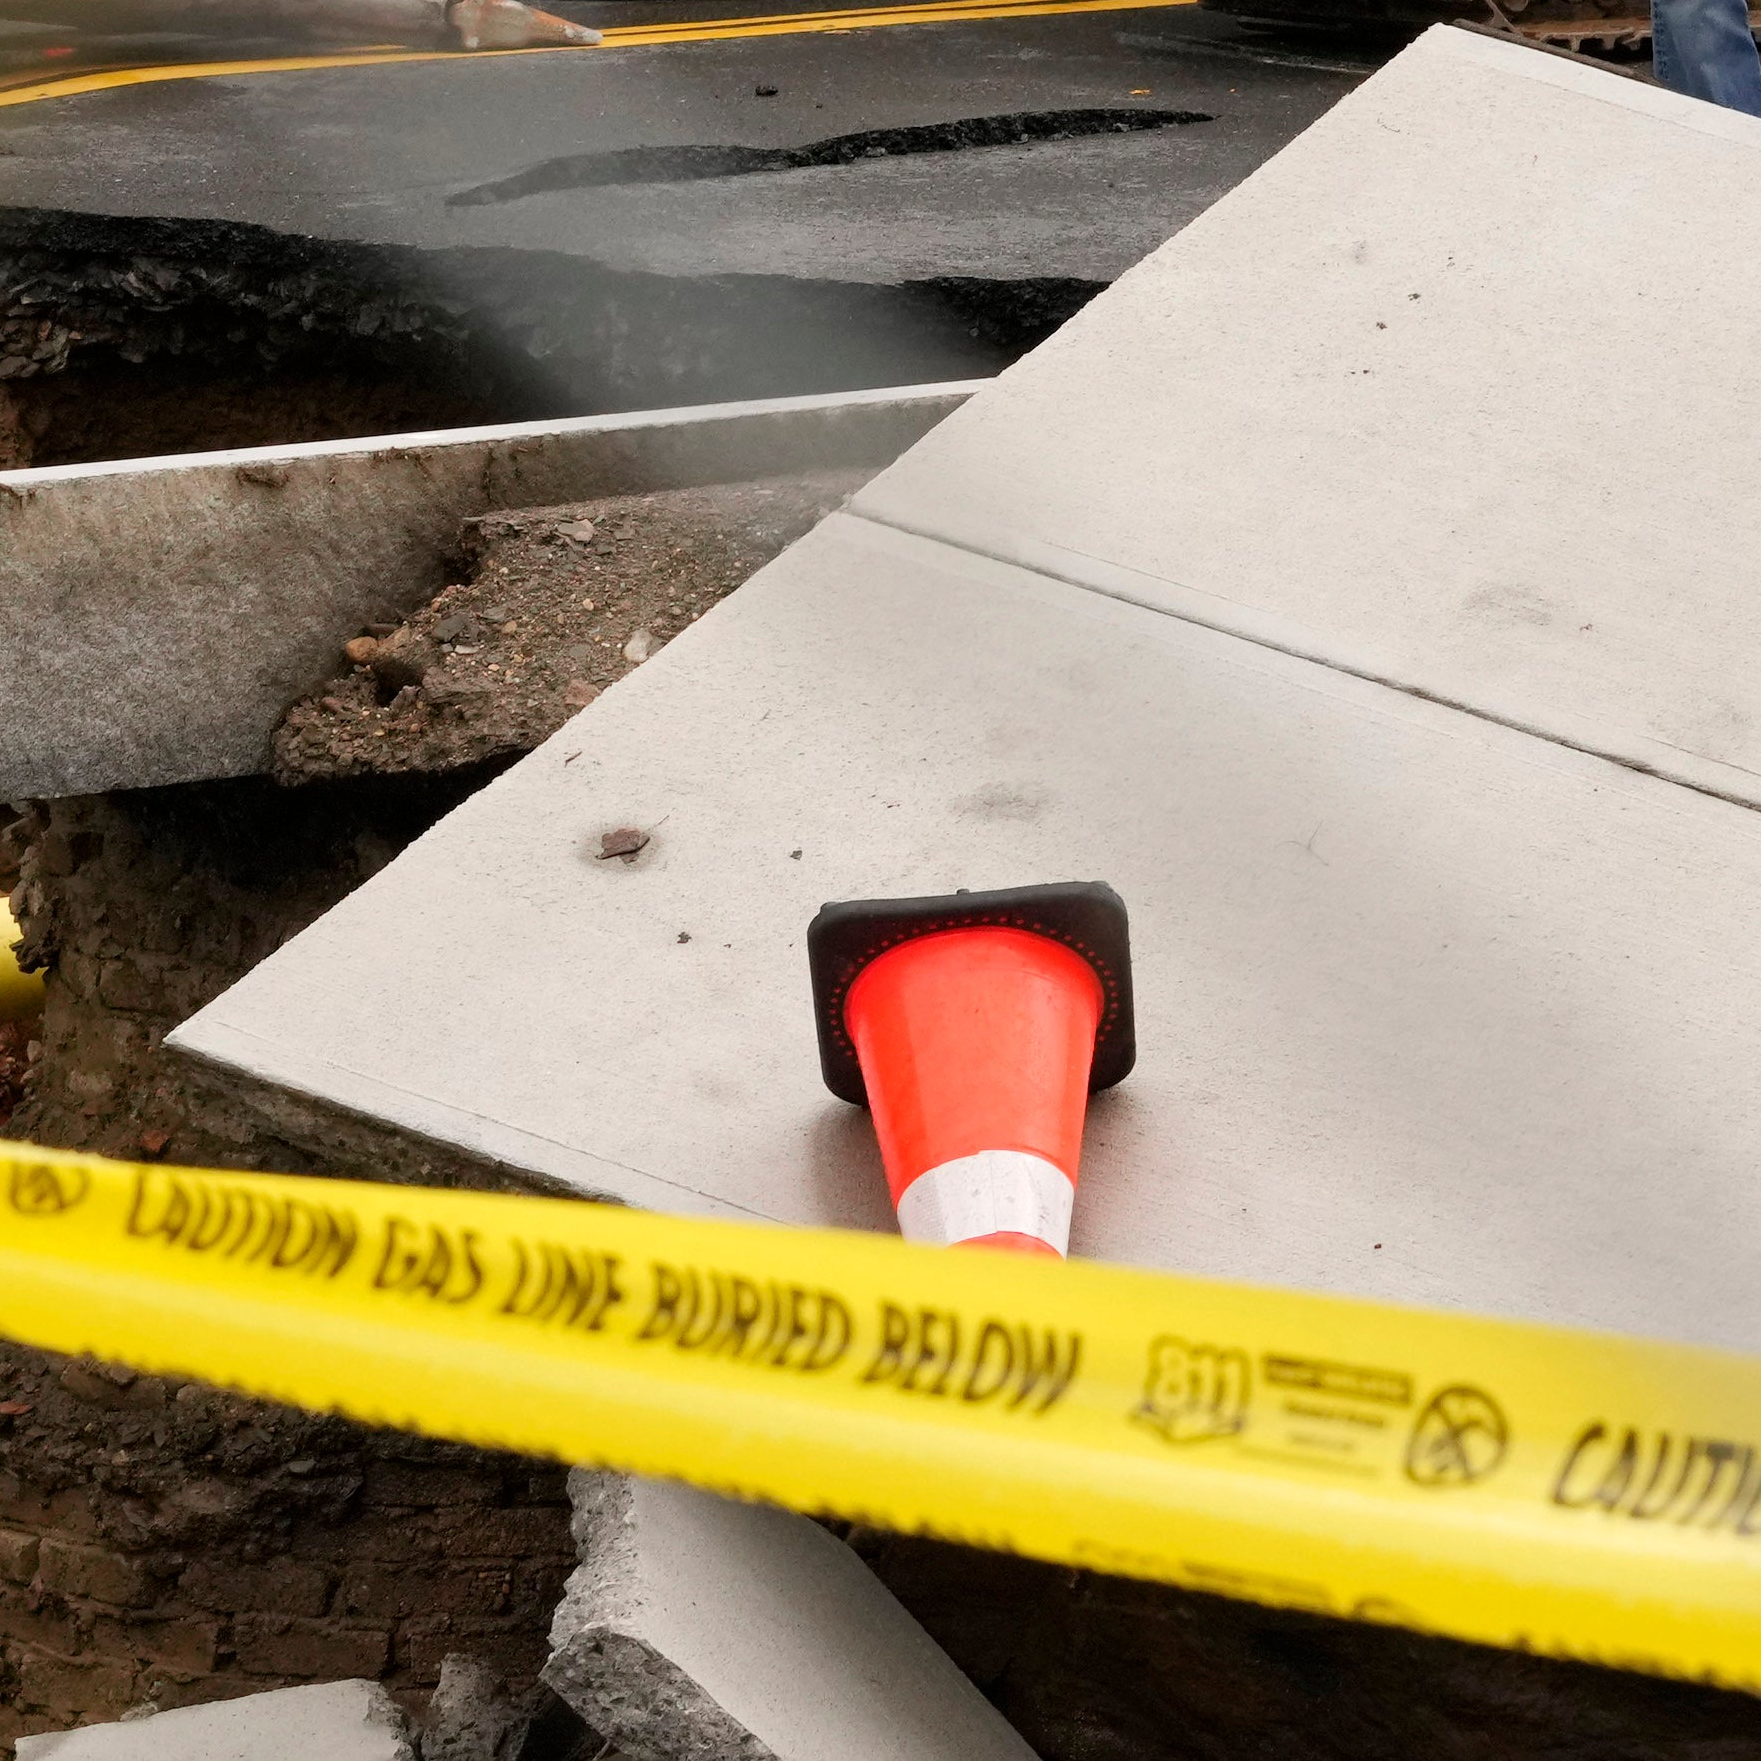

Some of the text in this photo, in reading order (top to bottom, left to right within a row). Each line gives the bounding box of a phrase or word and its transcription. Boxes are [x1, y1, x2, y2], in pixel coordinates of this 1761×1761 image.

[125, 1166, 358, 1279] CAUTION
[372, 1217, 483, 1305] GAS
[499, 1238, 625, 1333] LINE
[638, 1263, 852, 1373] BURIED
[862, 1297, 1083, 1416] BELOW
